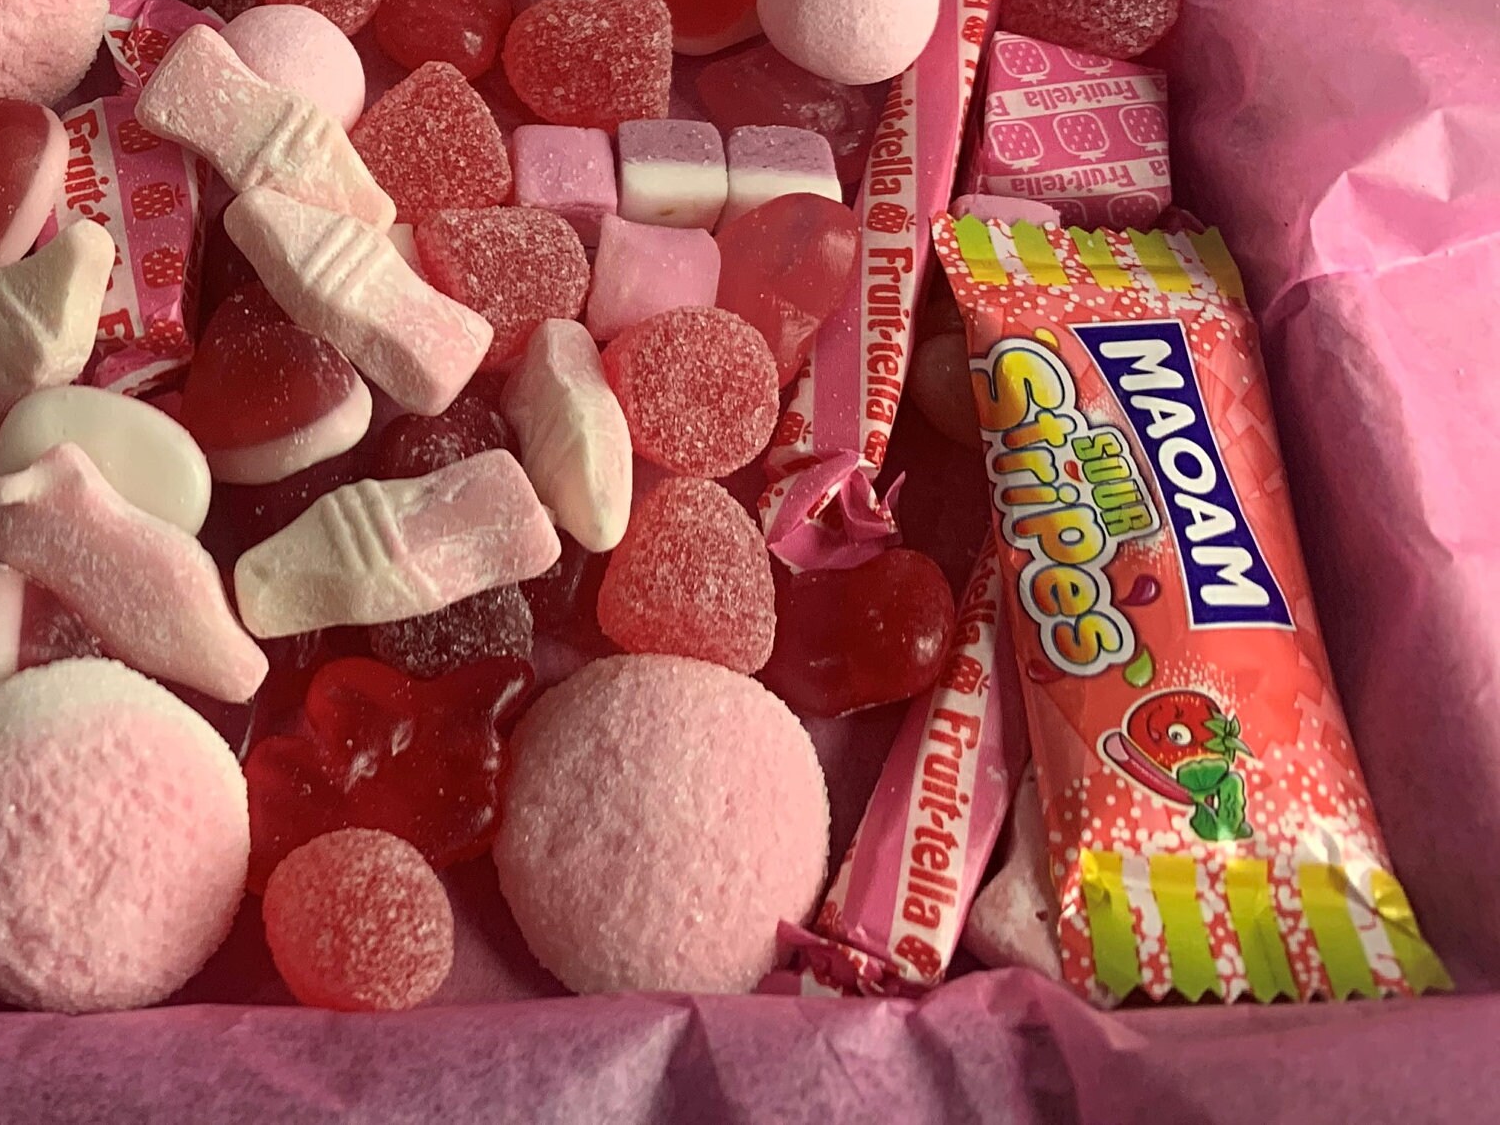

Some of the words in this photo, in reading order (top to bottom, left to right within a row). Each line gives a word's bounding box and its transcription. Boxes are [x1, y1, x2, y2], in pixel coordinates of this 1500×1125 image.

[1010, 164, 1138, 196] Fruit-tella
[1023, 79, 1141, 111] Fruit-tella
[865, 246, 914, 425] Fruit-tella
[970, 347, 1124, 665] Stripes
[1071, 431, 1154, 537] SOUR
[1099, 338, 1271, 607] MAOAM
[903, 708, 982, 931] Fruit-tella
